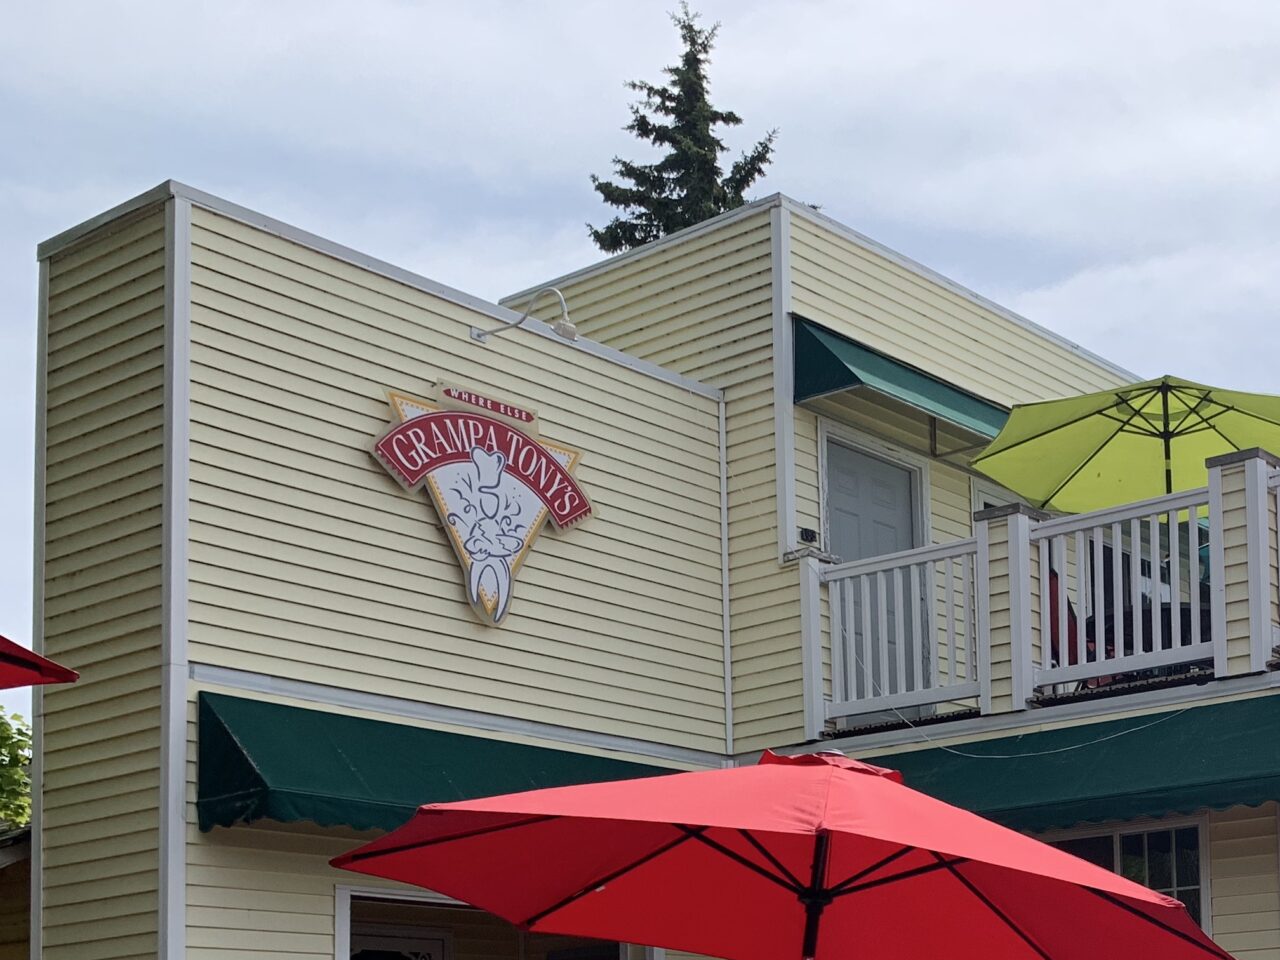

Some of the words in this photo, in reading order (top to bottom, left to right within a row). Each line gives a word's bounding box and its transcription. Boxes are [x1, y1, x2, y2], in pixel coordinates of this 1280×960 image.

[450, 388, 492, 409] WHERE
[500, 404, 527, 420] ELSE
[392, 418, 498, 471] GRAMPA
[506, 431, 579, 516] TONY'S
